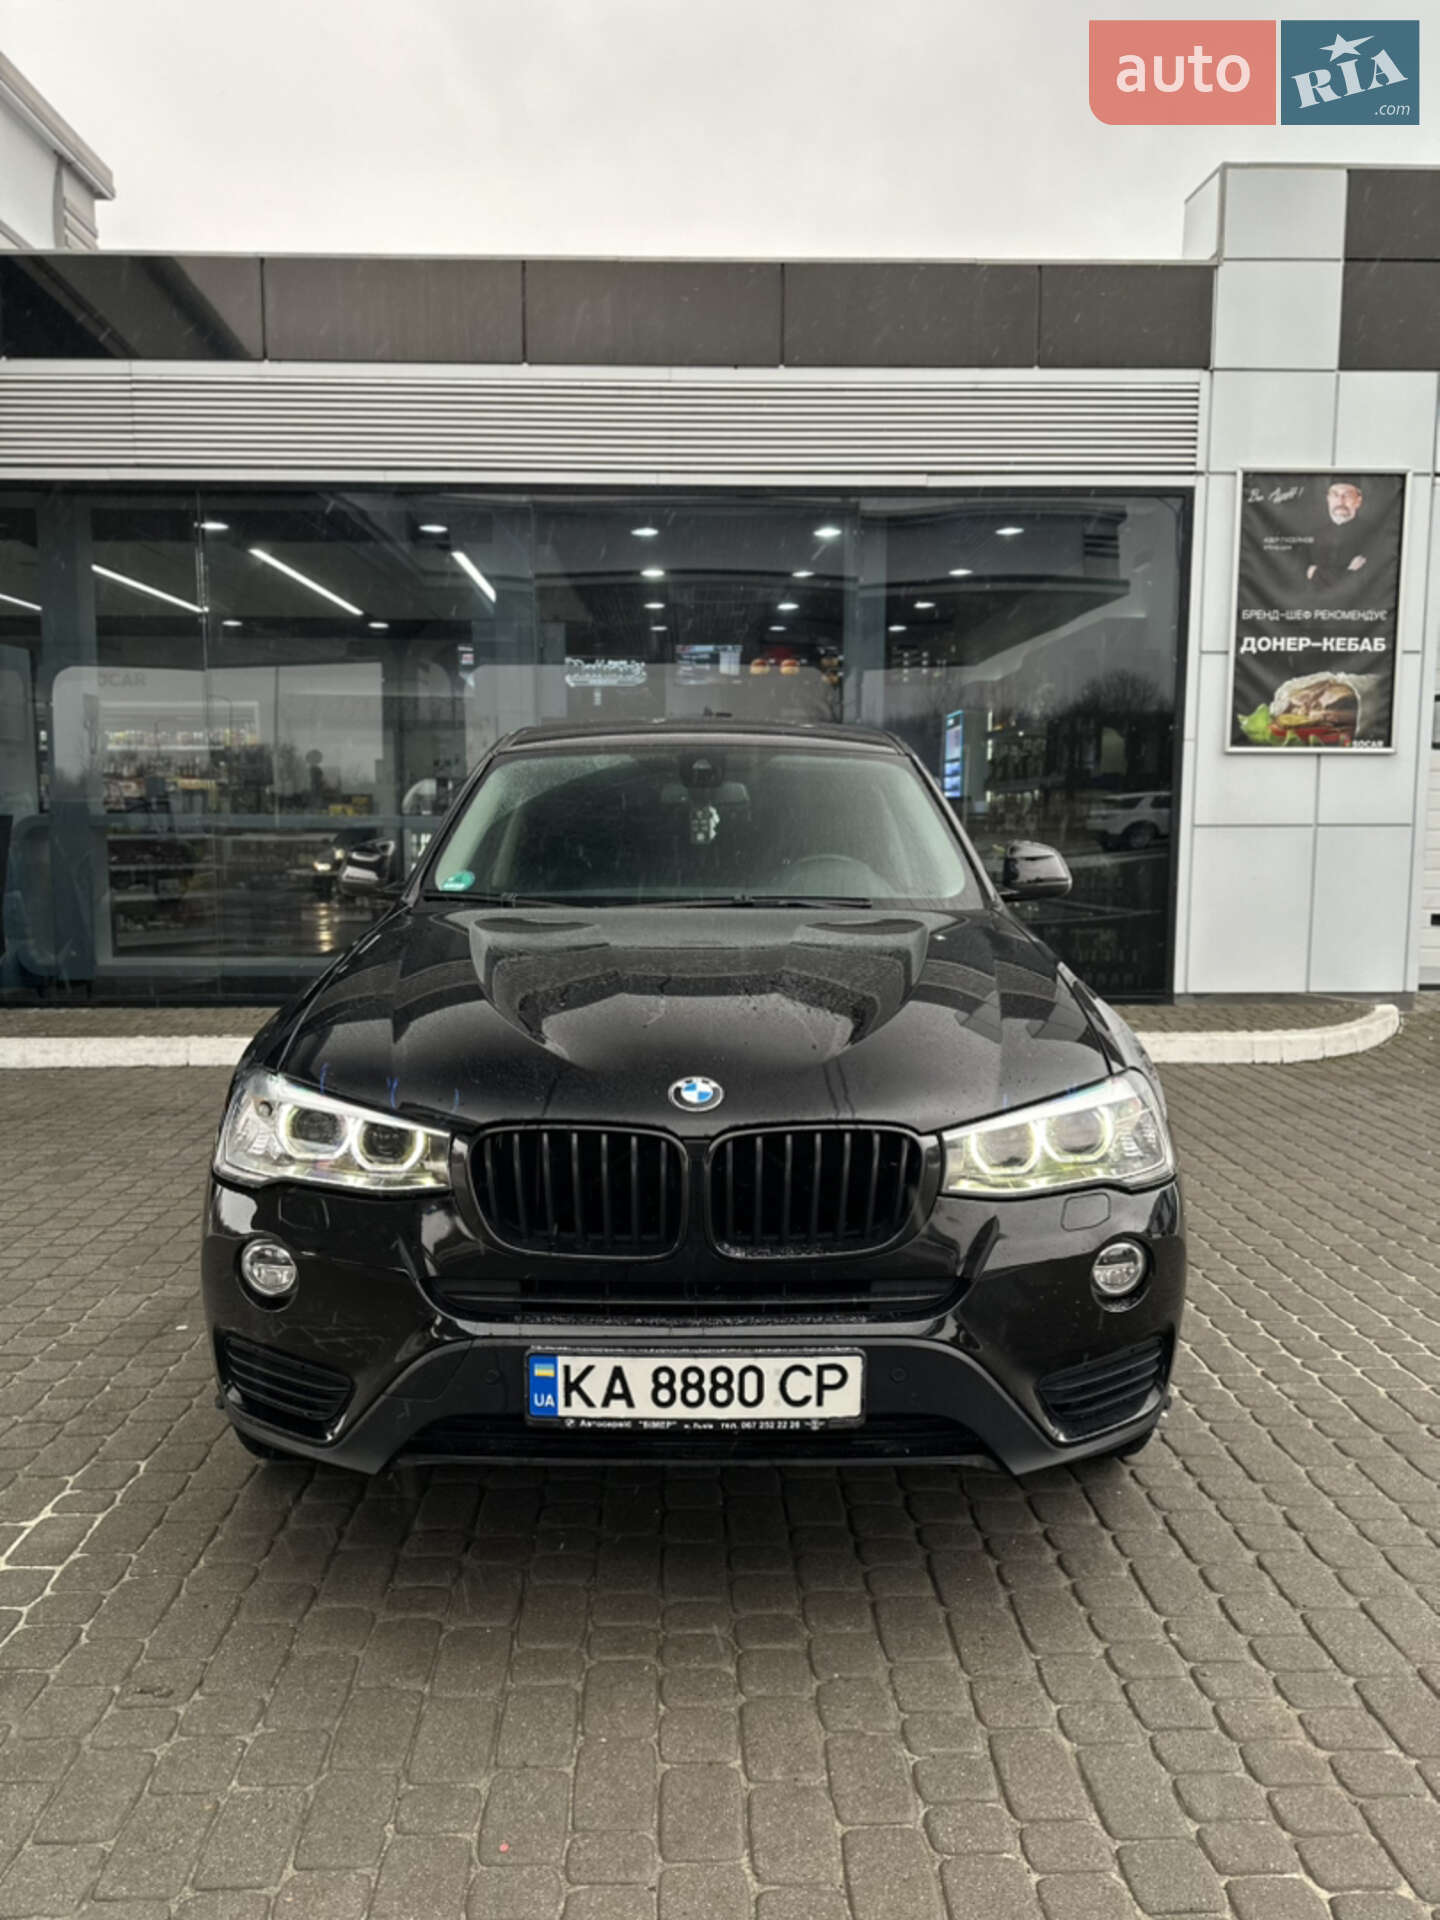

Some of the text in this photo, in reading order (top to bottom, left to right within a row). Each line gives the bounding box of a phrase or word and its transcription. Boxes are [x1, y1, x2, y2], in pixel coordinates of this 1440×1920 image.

[1239, 636, 1387, 655] ДОНЕР-КЕБАБ
[563, 1363, 849, 1409] KA 8880 CP
[533, 1393, 556, 1408] UA
